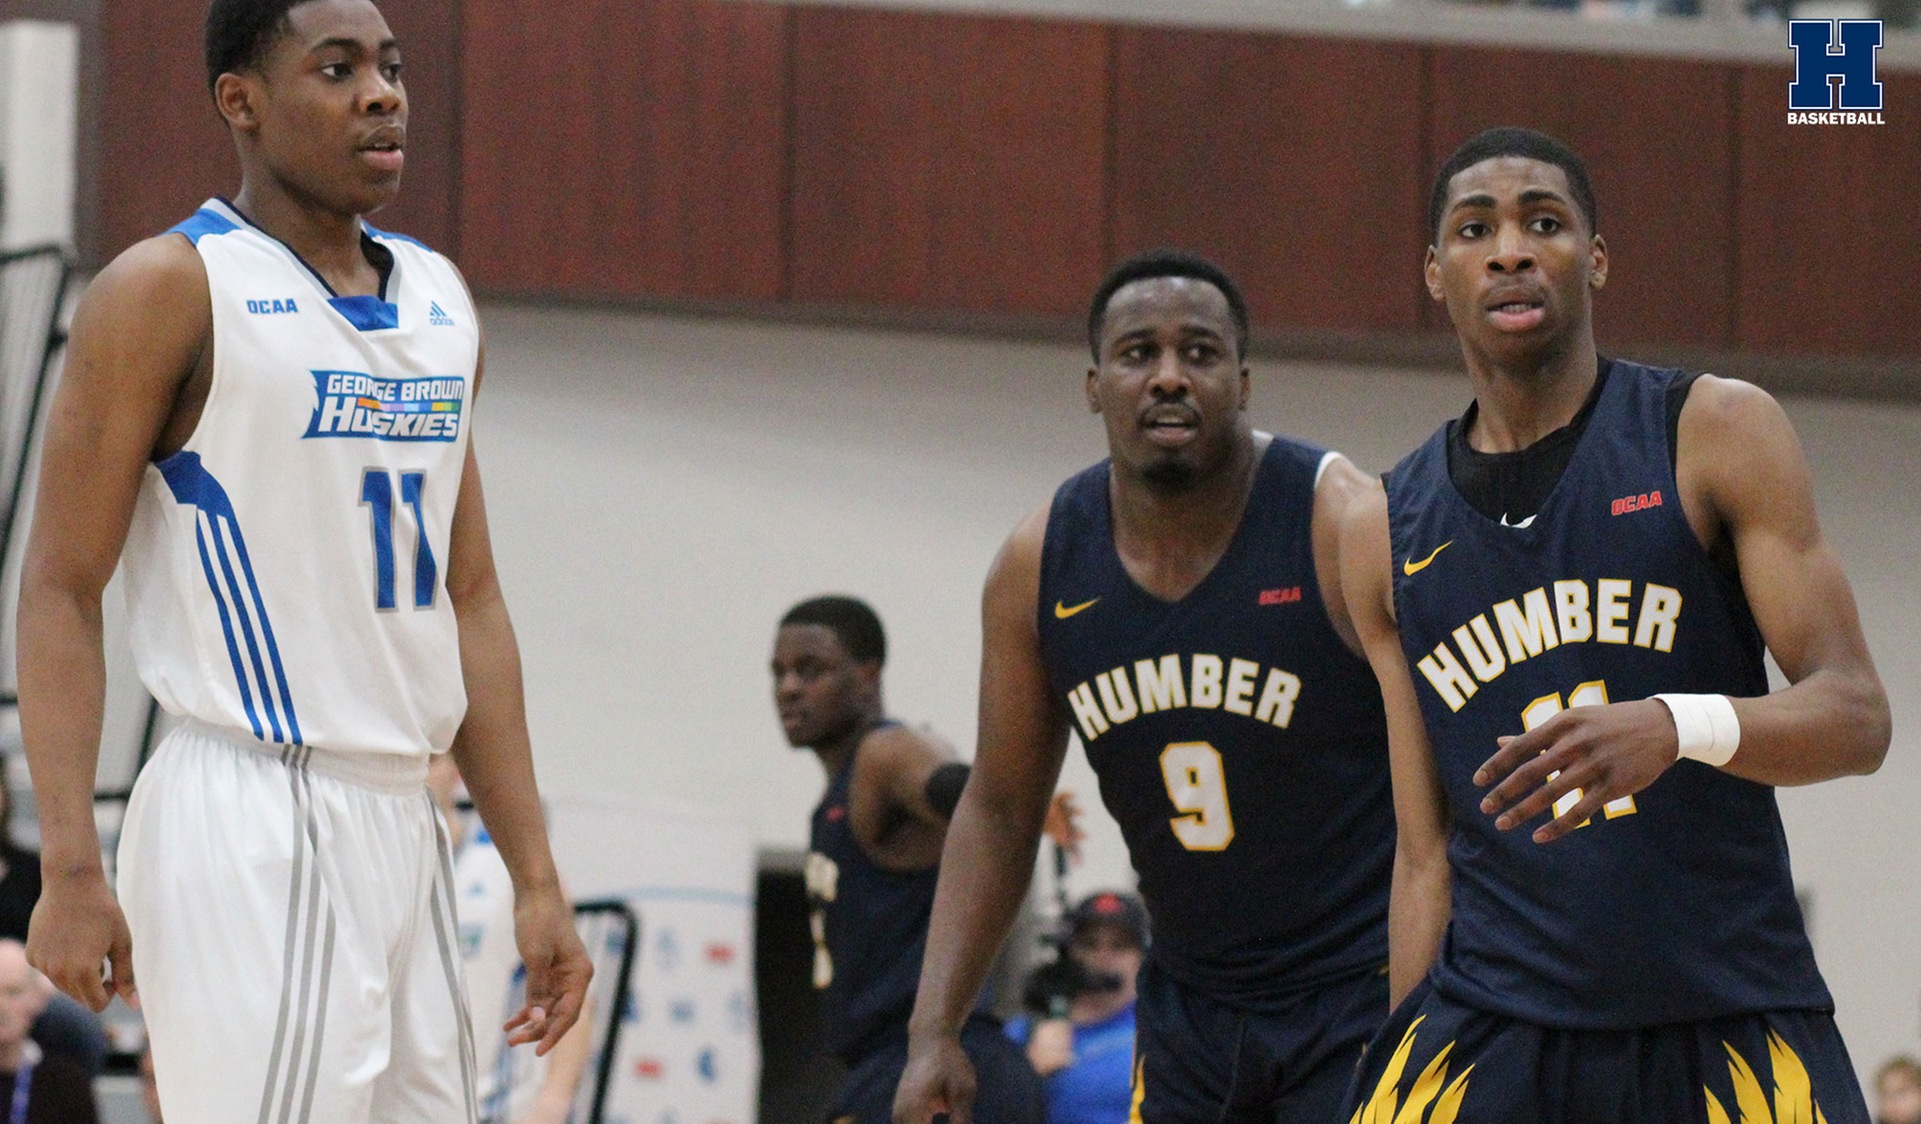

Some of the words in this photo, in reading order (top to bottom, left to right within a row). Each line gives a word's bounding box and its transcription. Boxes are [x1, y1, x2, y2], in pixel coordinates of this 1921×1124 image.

[246, 298, 299, 314] OCAA
[317, 396, 459, 437] HUSKIES
[326, 374, 397, 401] GEORGE
[401, 380, 463, 401] BROWN
[1611, 491, 1663, 516] OCAA
[358, 466, 437, 613] 11
[1417, 578, 1683, 713] HUMBER
[1067, 653, 1301, 741] HUMBER
[1159, 741, 1235, 851] 9
